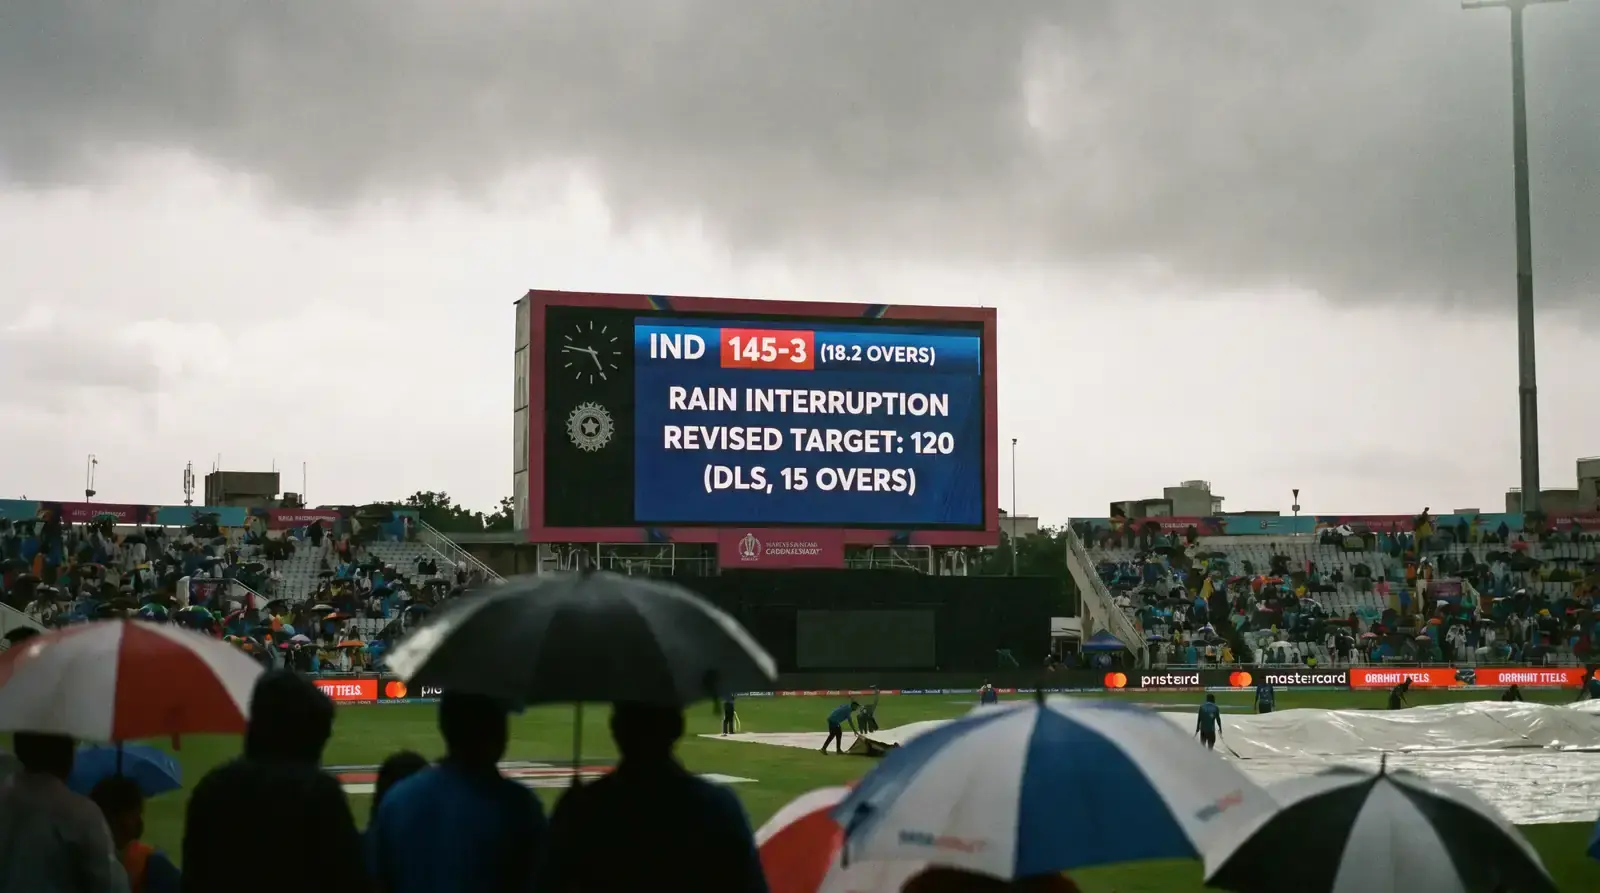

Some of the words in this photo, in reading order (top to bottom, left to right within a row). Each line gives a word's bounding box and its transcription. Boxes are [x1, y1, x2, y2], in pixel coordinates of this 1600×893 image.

[650, 333, 706, 360] IND
[728, 336, 807, 363] 145-3
[820, 343, 862, 363] (18.2
[866, 345, 936, 366] OVERS)
[669, 386, 737, 411] RAIN
[746, 388, 949, 417] INTERRUPTION
[664, 425, 783, 451] REVISED
[789, 428, 904, 454] TARGET:
[910, 431, 955, 455] 120
[703, 463, 773, 494] (DLS,
[780, 467, 809, 491] 15
[815, 467, 916, 496] OVERS)
